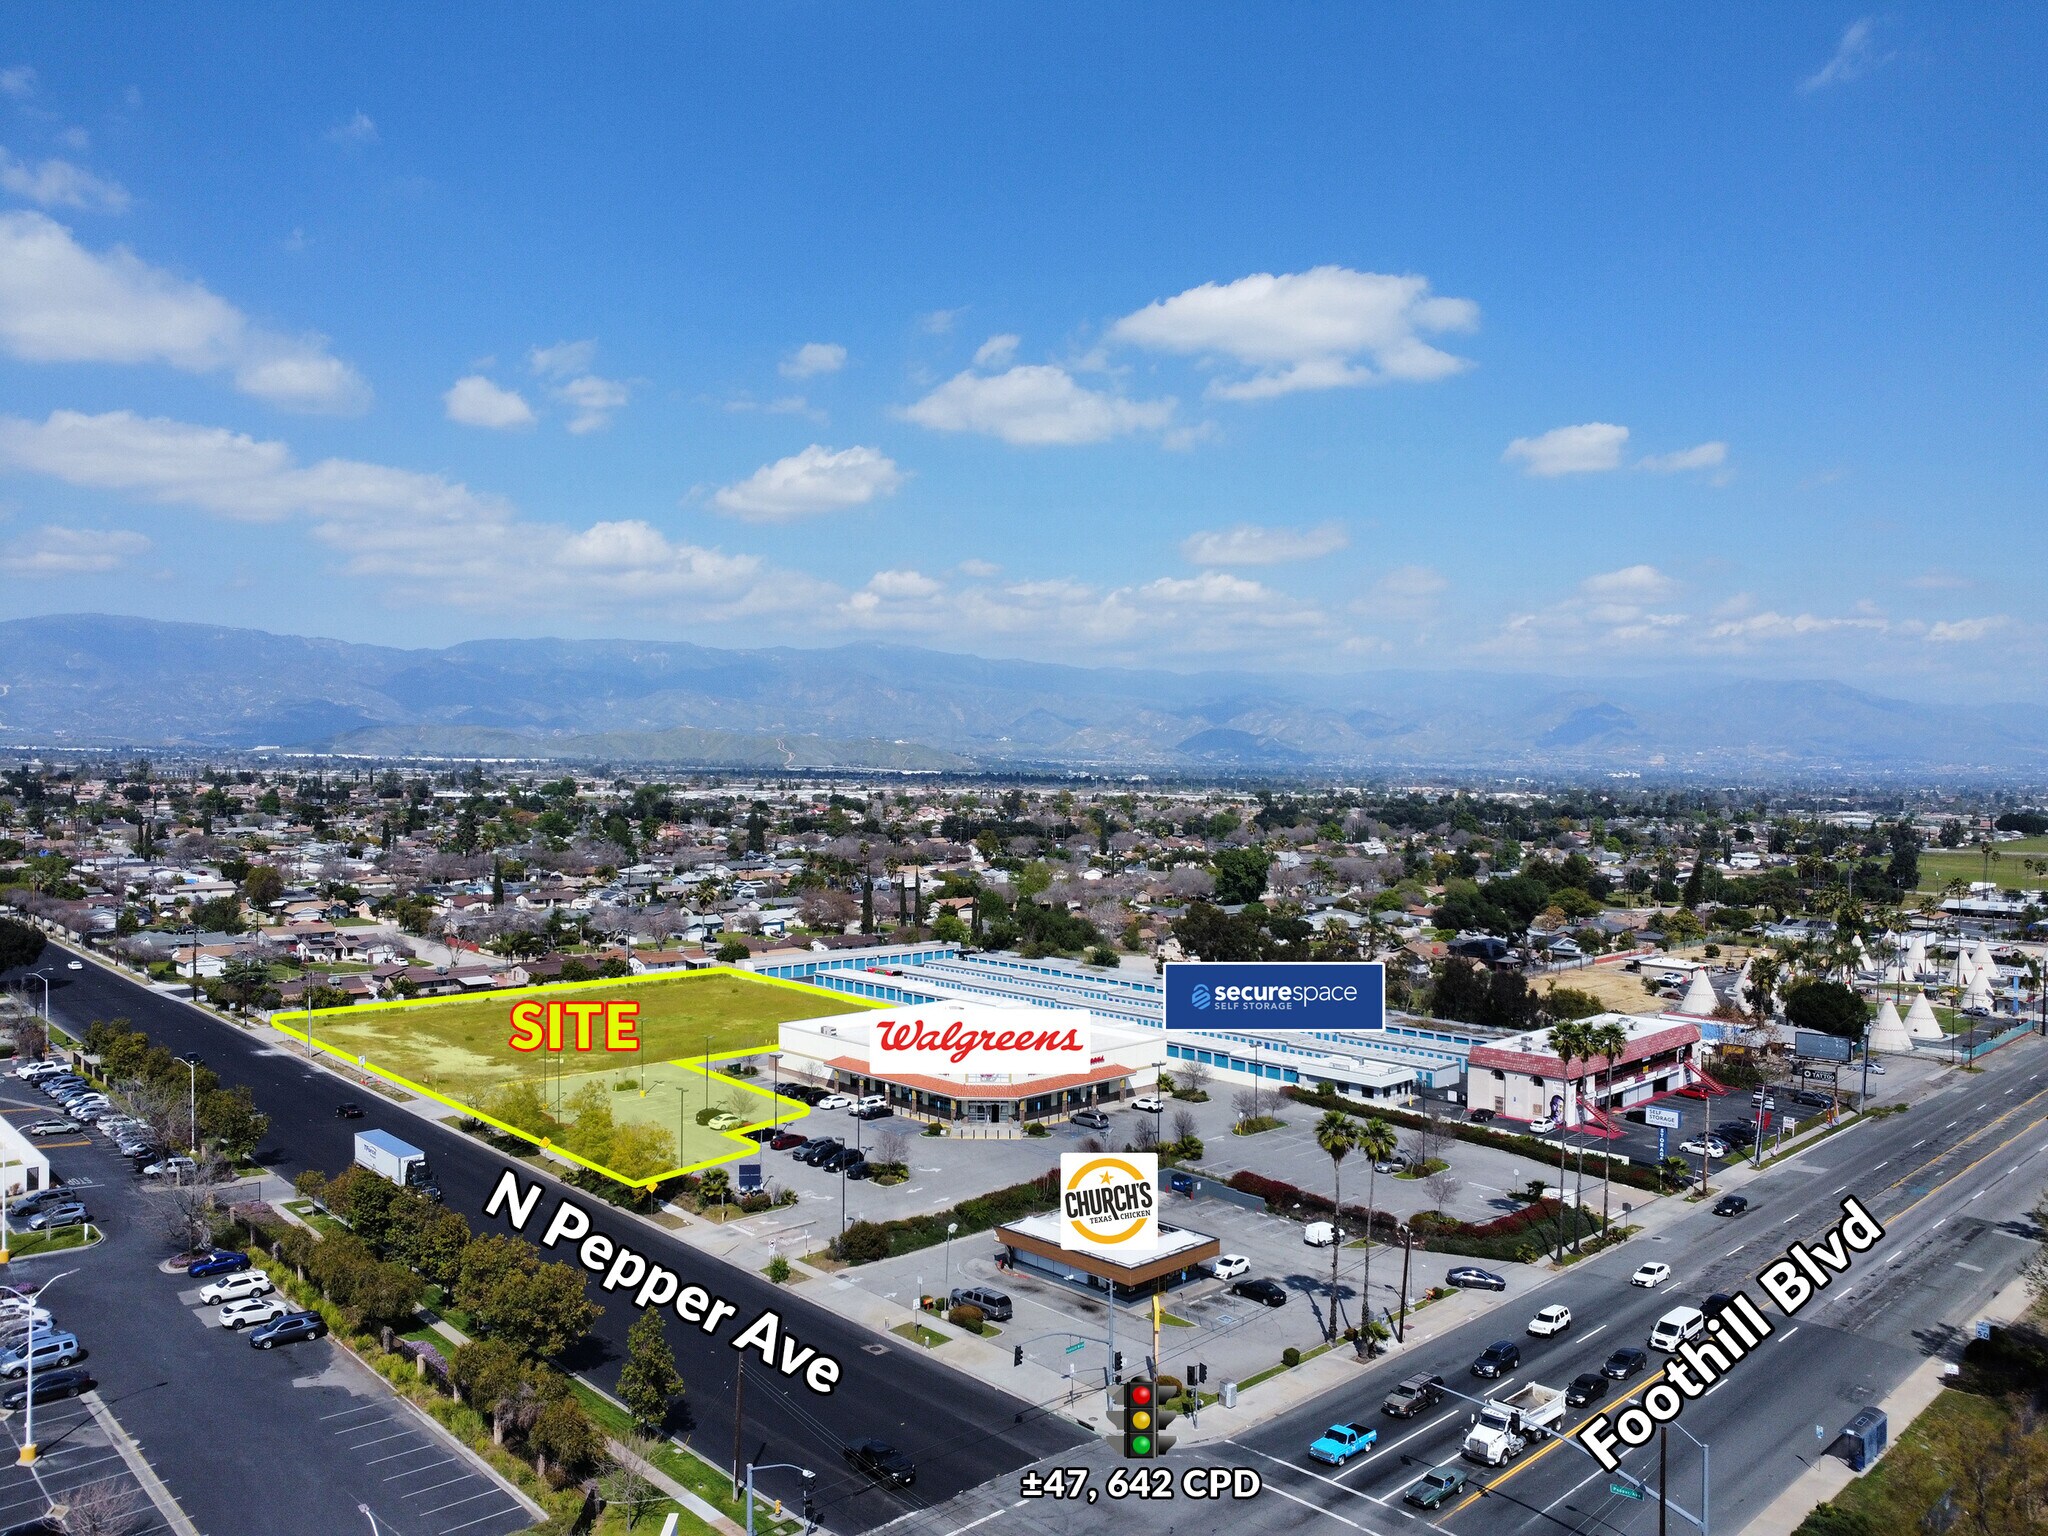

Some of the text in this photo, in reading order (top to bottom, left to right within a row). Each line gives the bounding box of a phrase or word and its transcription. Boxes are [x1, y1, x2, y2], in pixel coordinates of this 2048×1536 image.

[1812, 1072, 1835, 1080] TATTOO
[1649, 1114, 1675, 1123] STORAGE
[67, 1176, 93, 1186] STOP
